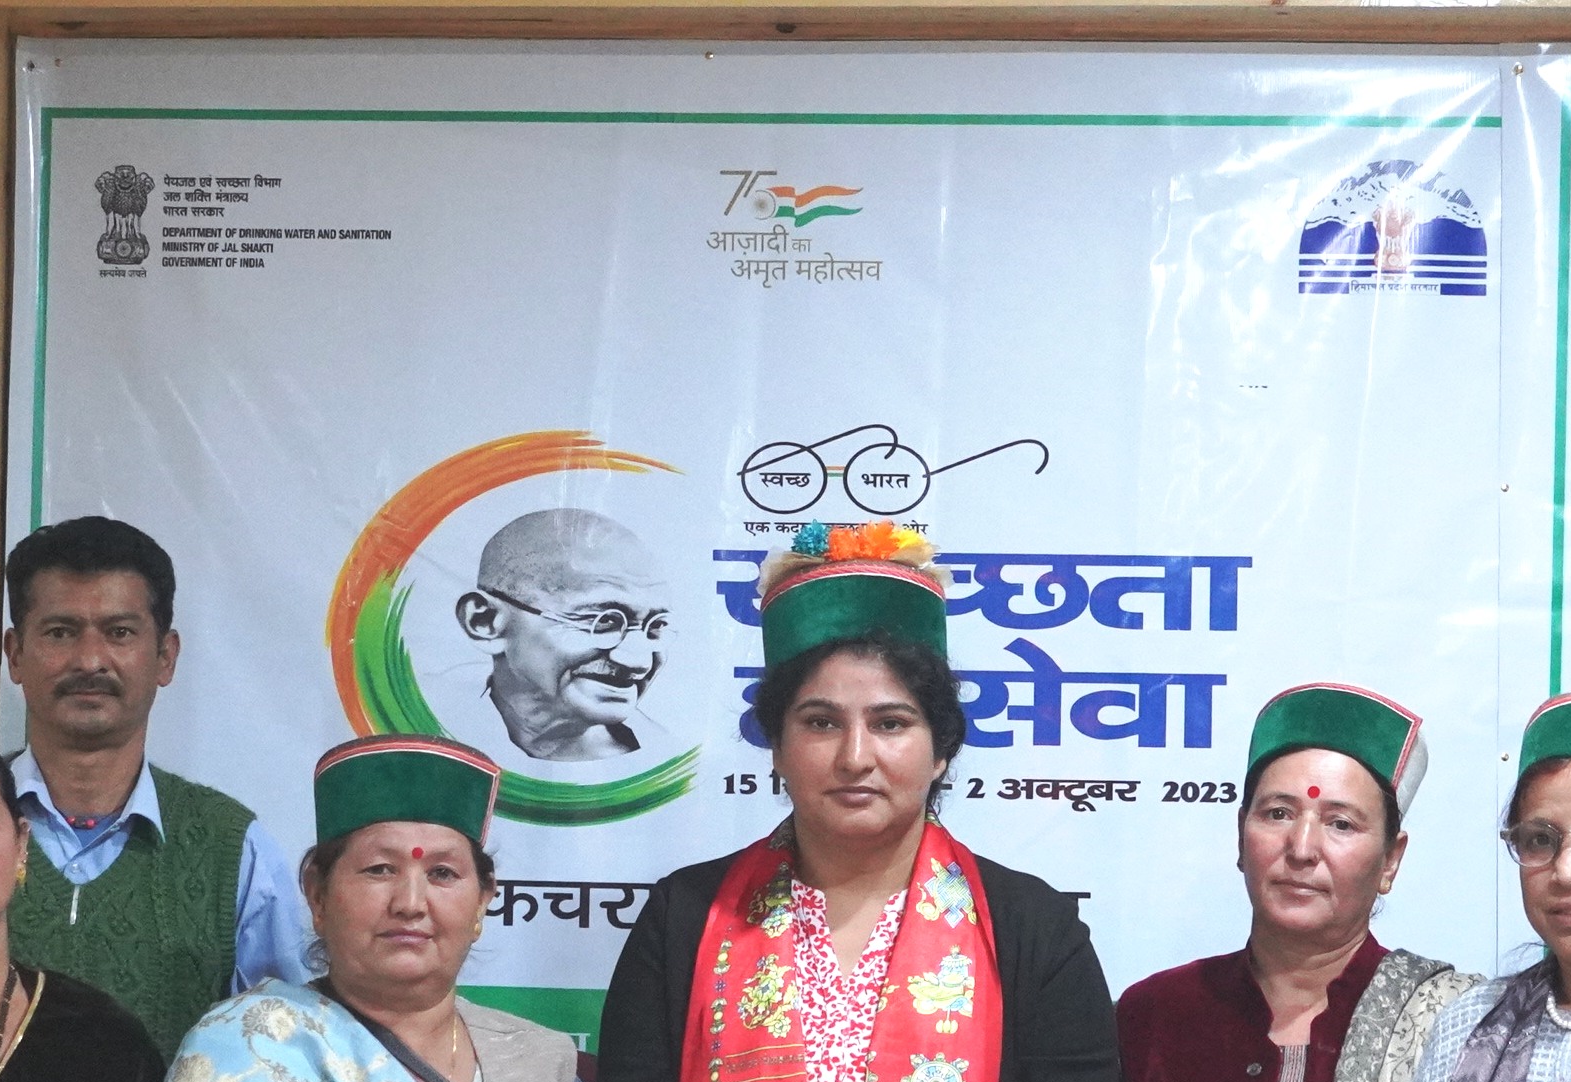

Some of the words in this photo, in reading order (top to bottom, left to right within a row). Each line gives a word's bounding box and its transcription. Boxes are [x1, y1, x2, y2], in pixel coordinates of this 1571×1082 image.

[163, 174, 196, 188] पेयजल
[199, 174, 212, 187] एवं
[254, 174, 282, 189] विभाग
[163, 191, 181, 202] जल
[185, 188, 211, 202] शक्ति
[215, 189, 249, 203] मंत्रालय
[163, 206, 188, 217] भारत
[191, 207, 225, 217] सरकार
[162, 227, 223, 238] DEPARTMENT
[225, 228, 237, 238] OF
[239, 228, 283, 239] DRINKING
[284, 229, 316, 239] WATER
[317, 229, 337, 240] AND
[339, 229, 392, 240] SANITATION
[162, 241, 205, 252] MINISTRY
[207, 242, 219, 253] OF
[221, 242, 239, 253] JAL
[241, 242, 274, 253] SHAKTI
[792, 238, 812, 253] का
[162, 256, 223, 268] GOVERNMENT
[225, 257, 238, 268] OF
[239, 257, 265, 268] INDIA
[731, 259, 789, 289] अमृत
[795, 252, 883, 284] महोत्सव
[760, 472, 811, 488] स्वच्छ
[861, 472, 910, 489] भारत
[744, 521, 770, 536] एक
[775, 521, 808, 534] कद
[723, 773, 758, 795] 15
[966, 778, 986, 798] 2
[997, 777, 1139, 812] अक्टूबर
[1162, 781, 1238, 804] 2023
